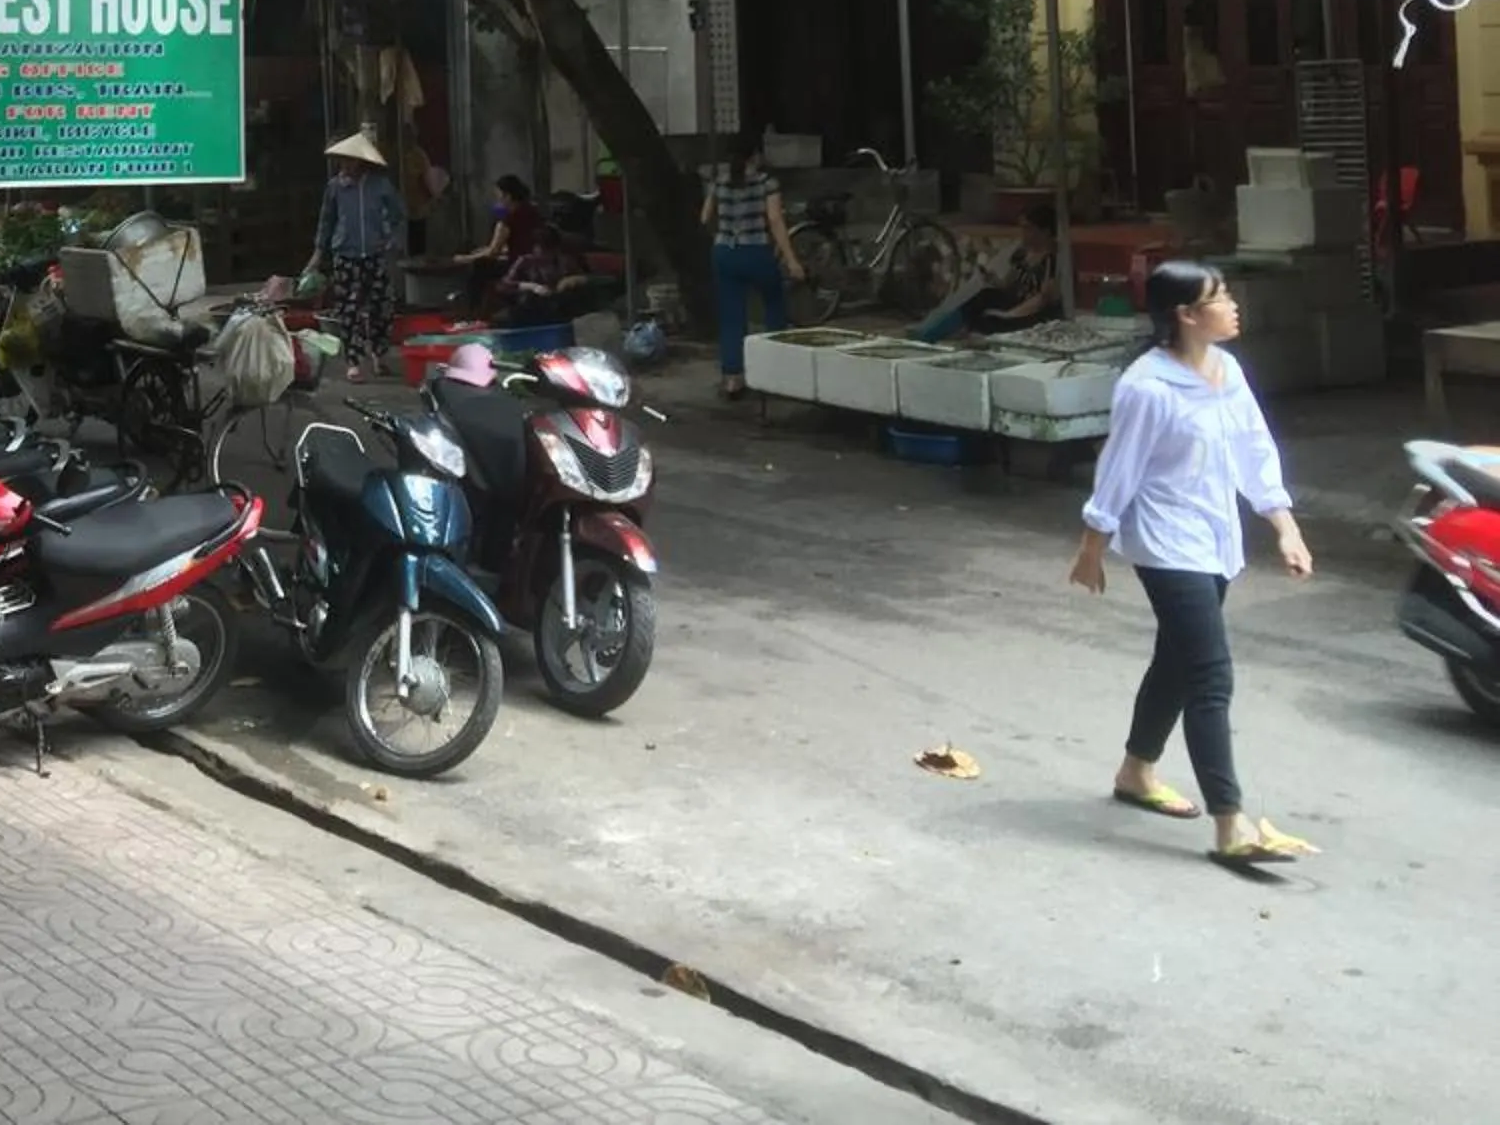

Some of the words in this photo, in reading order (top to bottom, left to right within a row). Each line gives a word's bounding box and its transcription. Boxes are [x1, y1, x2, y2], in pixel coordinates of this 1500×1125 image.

[19, 62, 125, 78] OFFICE
[5, 105, 67, 120] FOR
[76, 104, 155, 120] RENT
[58, 124, 156, 141] BICYCLE
[33, 143, 195, 159] RESTAURANT
